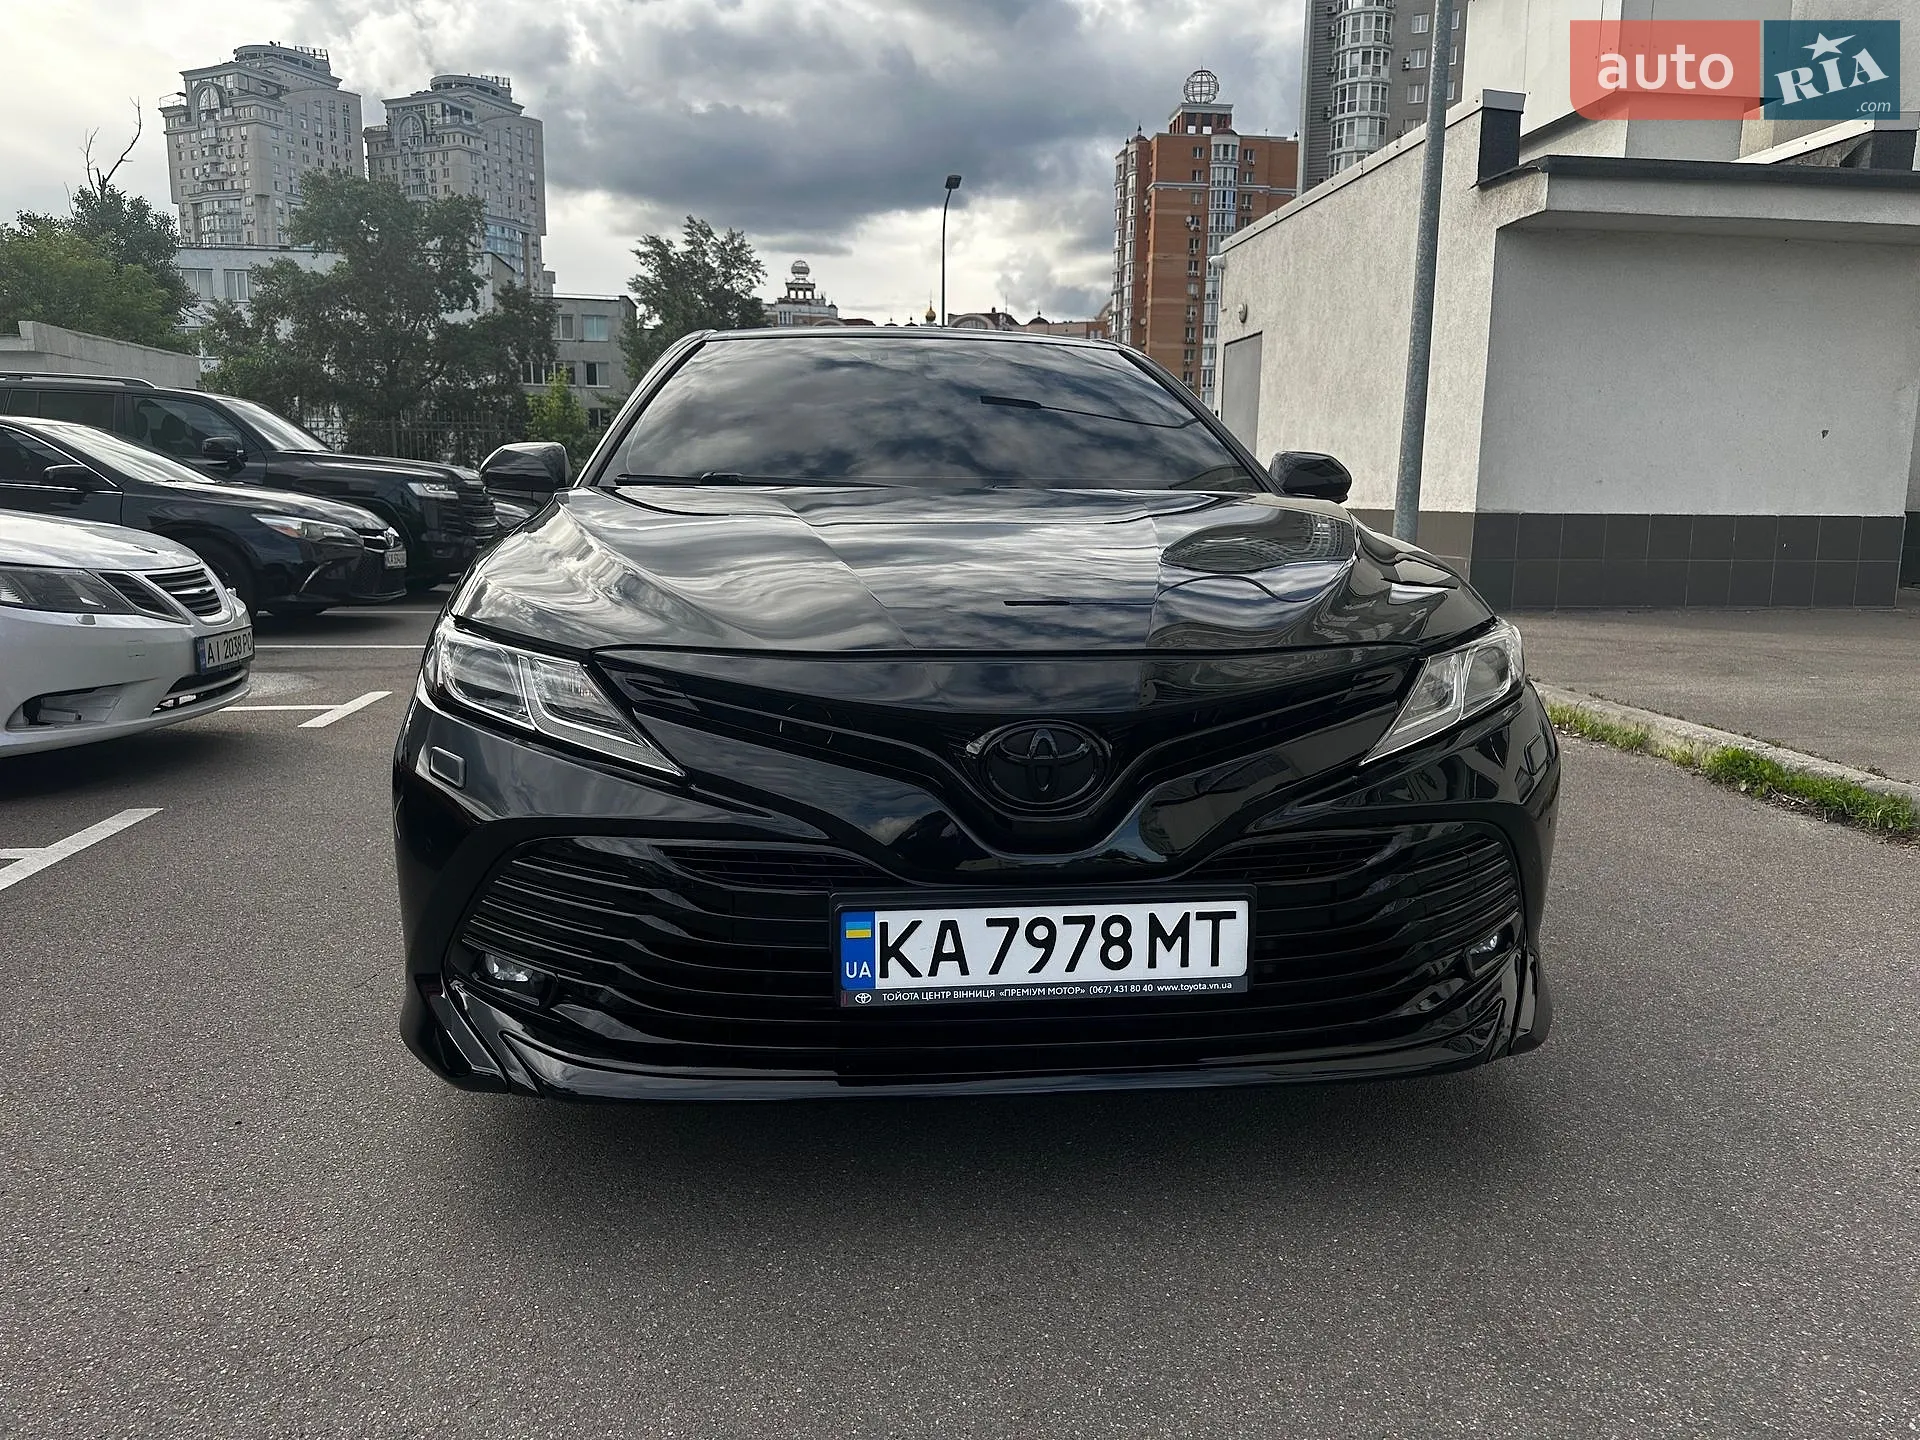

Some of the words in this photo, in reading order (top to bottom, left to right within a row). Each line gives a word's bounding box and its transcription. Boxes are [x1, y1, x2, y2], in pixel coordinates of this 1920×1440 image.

[879, 920, 970, 979] KA
[986, 914, 1133, 975] 7978
[1147, 911, 1237, 969] MT
[845, 961, 872, 979] UA
[882, 991, 920, 1001] ТОЙОТА
[921, 990, 952, 1000] ЦЕНТР
[953, 989, 995, 999] ВІННИЦЯ
[1047, 986, 1086, 996] МОТОР»
[1089, 985, 1112, 995] (067)
[1113, 985, 1128, 993] 431
[1129, 984, 1141, 993] 80
[1142, 983, 1154, 992] 40
[1156, 981, 1233, 993] www.toyota.vn.ua
